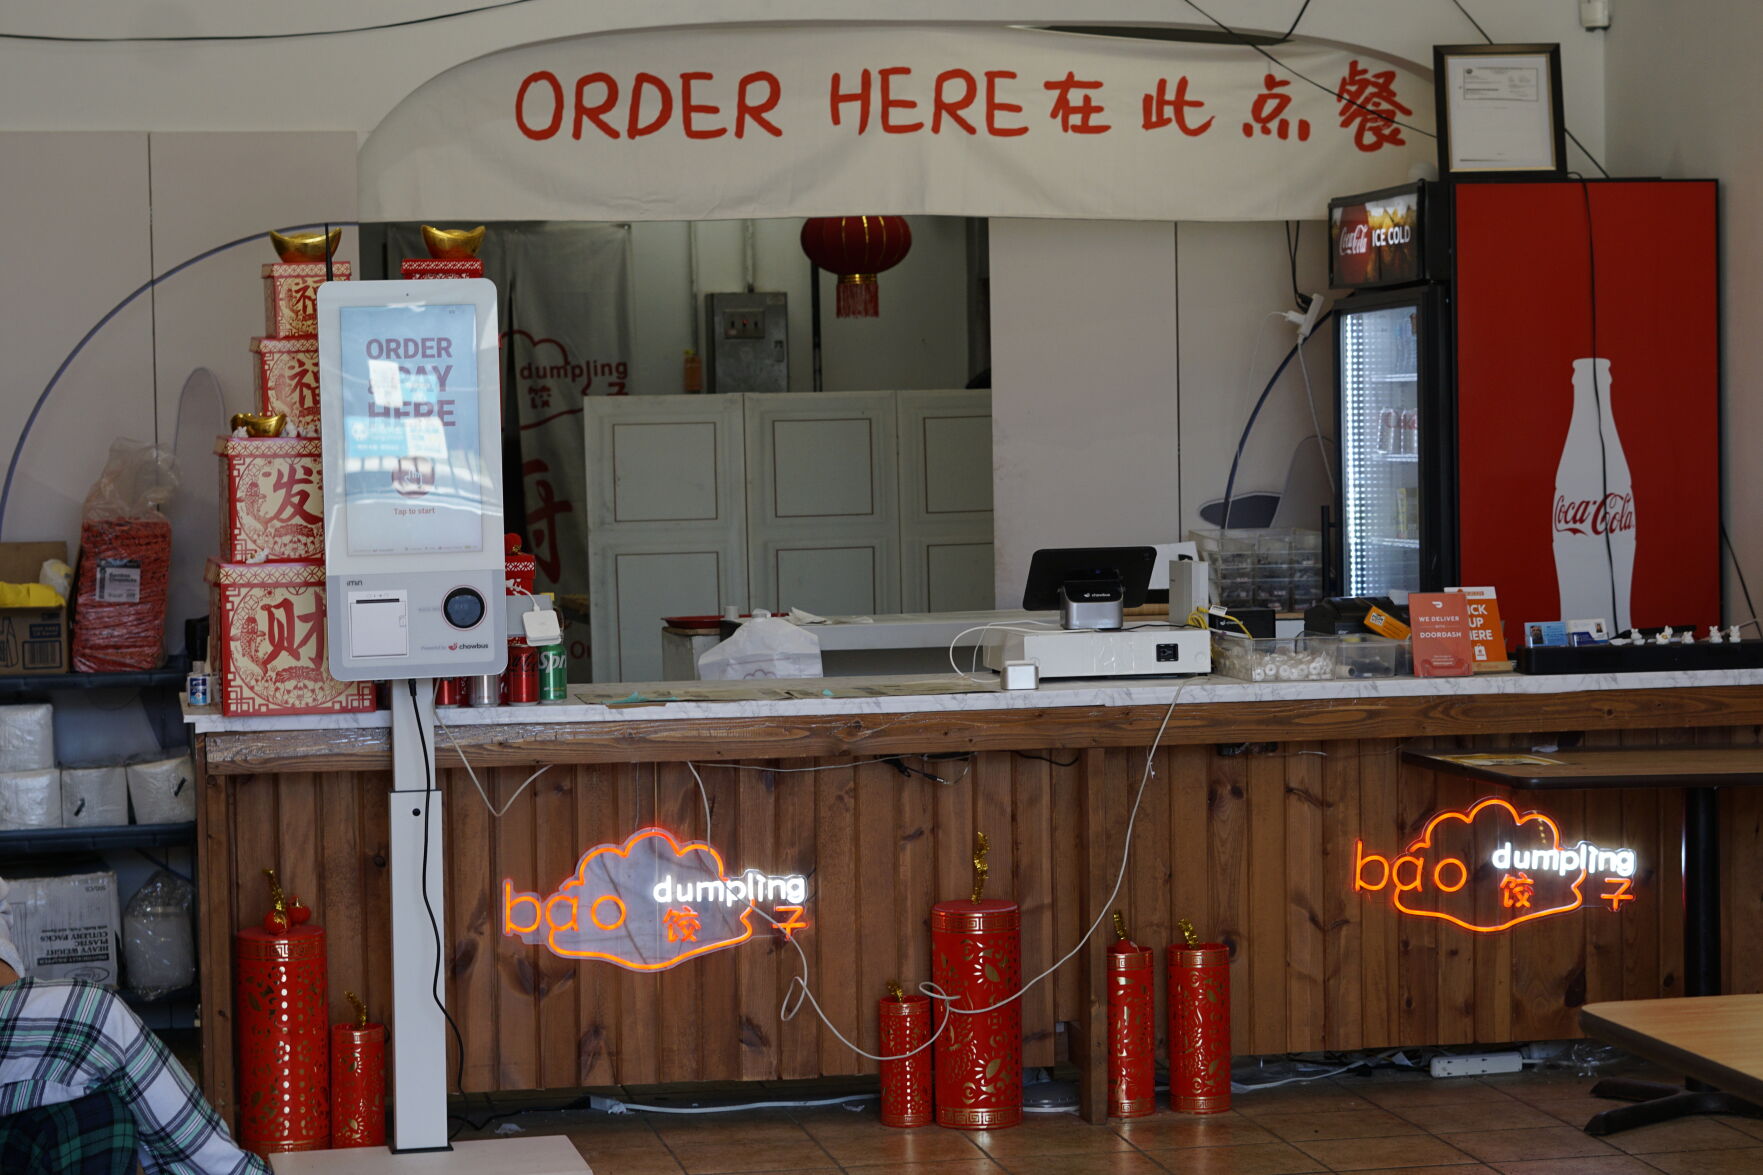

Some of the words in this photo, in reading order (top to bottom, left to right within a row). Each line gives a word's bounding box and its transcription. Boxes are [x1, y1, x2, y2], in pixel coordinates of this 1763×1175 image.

[515, 70, 783, 141] ORDER
[829, 66, 1029, 137] HERE
[1044, 62, 1413, 152] 在此点餐
[1372, 228, 1386, 248] ICE
[1388, 225, 1411, 245] COLD
[365, 336, 453, 360] ORDER
[519, 360, 628, 383] dumpling
[263, 462, 324, 526] 发
[393, 507, 407, 516] Tap
[1554, 492, 1633, 536] Coca-Cola
[1466, 604, 1488, 615] ICK
[260, 590, 327, 676] 财
[1468, 617, 1484, 628] UP
[459, 642, 489, 650] chowbus
[1419, 631, 1462, 639] DOORDASH
[1354, 839, 1467, 892] bao
[1492, 842, 1636, 877] dumpling
[505, 881, 627, 935] bao
[652, 873, 807, 907] dumpling
[75, 938, 109, 947] PLASTIC
